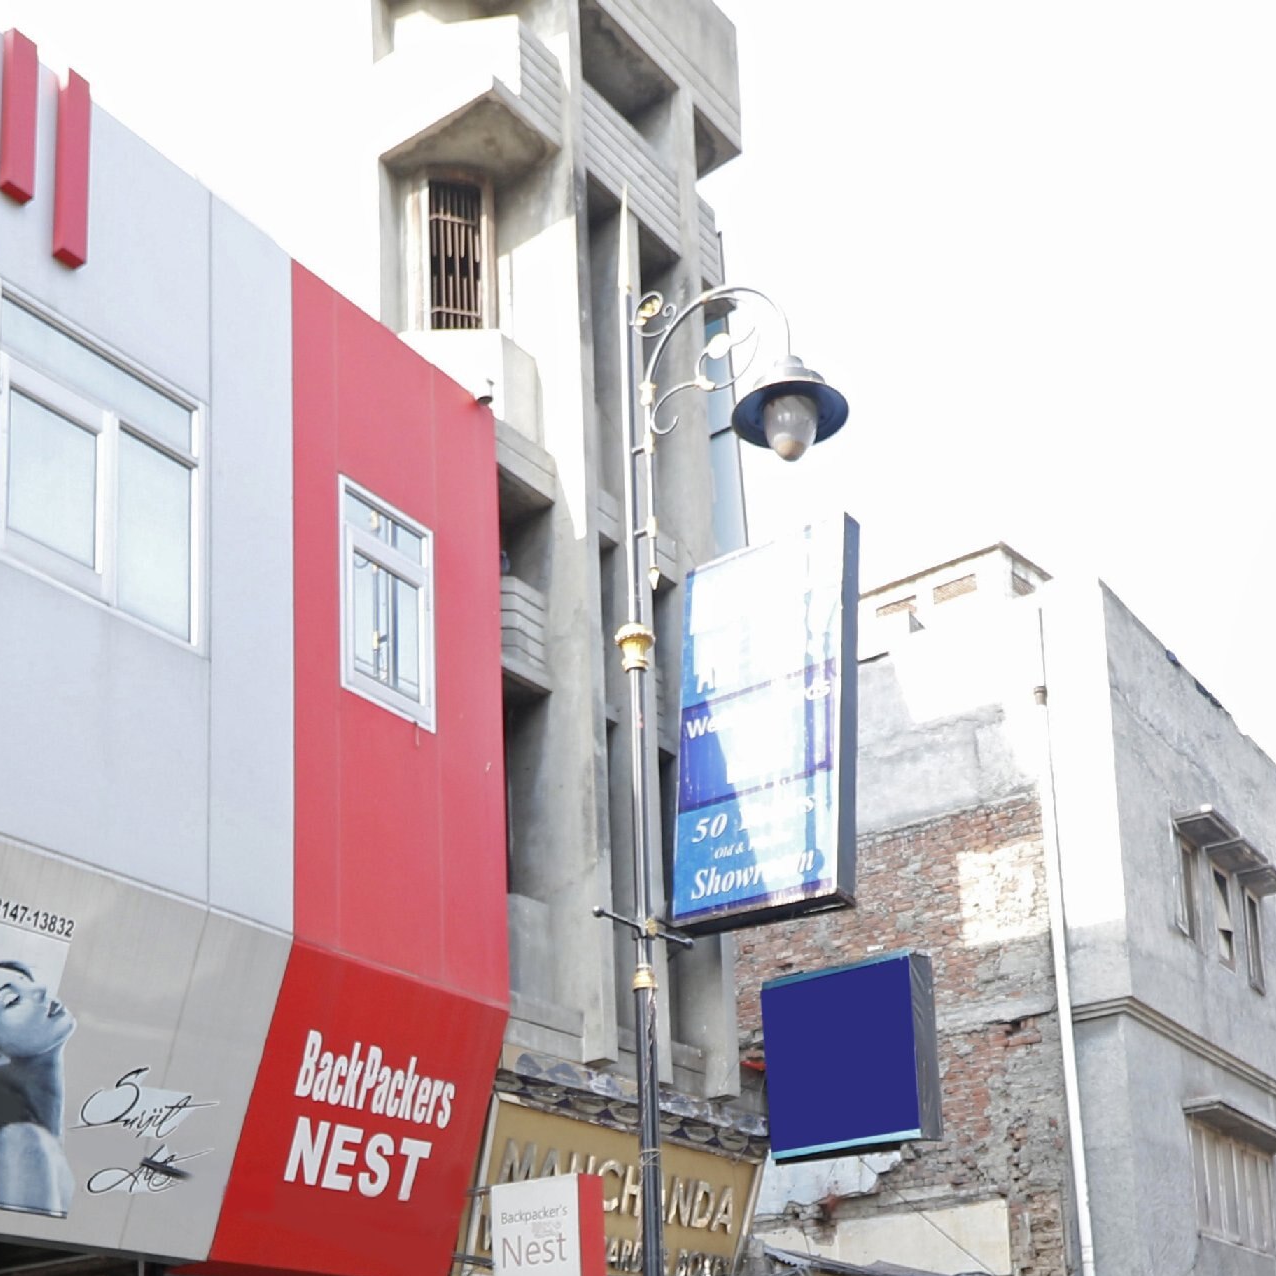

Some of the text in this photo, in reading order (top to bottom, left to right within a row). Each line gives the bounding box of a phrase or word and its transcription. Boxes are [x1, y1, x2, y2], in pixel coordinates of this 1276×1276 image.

[691, 813, 728, 844] 50
[294, 1029, 456, 1130] BackPackers
[283, 1115, 434, 1202] NEST
[500, 1203, 569, 1226] Backpacker's
[502, 1232, 568, 1269] Nest
